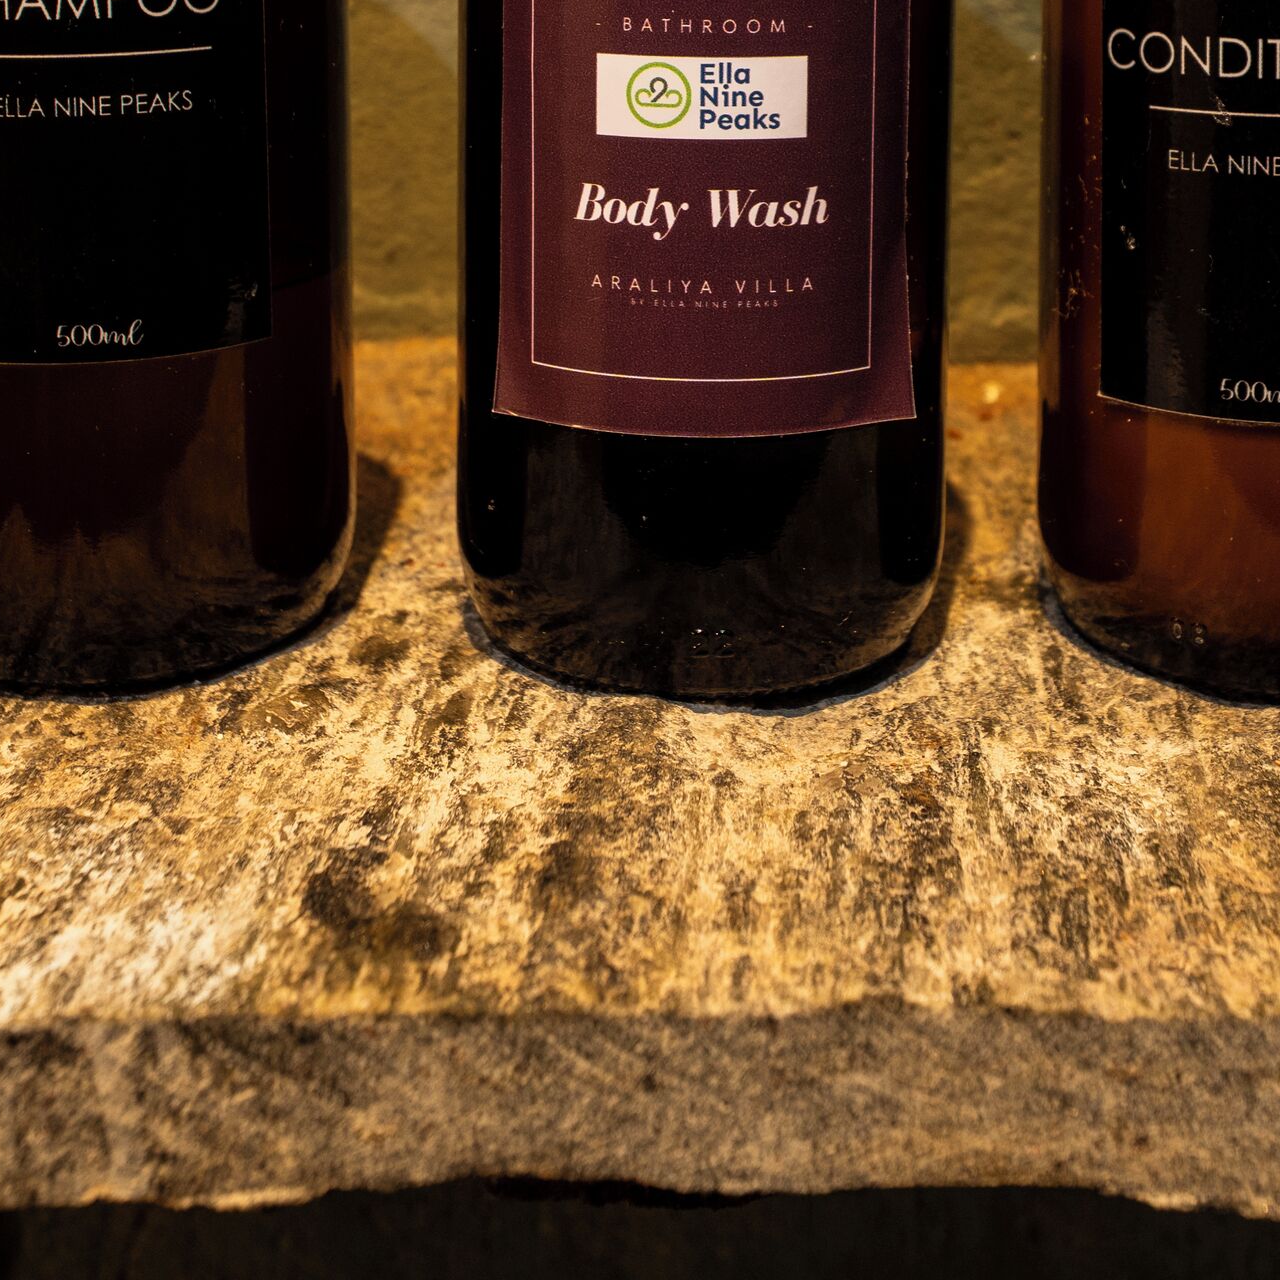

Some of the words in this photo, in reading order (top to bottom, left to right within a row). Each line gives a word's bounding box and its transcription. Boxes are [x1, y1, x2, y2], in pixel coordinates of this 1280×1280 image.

[623, 17, 786, 34] BATHROOM
[699, 62, 751, 85] Ella
[54, 95, 113, 117] NINE
[120, 90, 194, 115] PEAKS
[699, 84, 764, 107] Nine
[699, 108, 781, 130] Peaks
[1167, 149, 1219, 174] ELLA
[573, 182, 690, 241] Body
[707, 185, 830, 227] Wash
[591, 274, 713, 295] ARALIYA
[735, 276, 814, 294] VILLA
[653, 299, 685, 308] ELLA
[694, 300, 728, 309] NINE
[737, 299, 779, 308] PEAKS
[55, 318, 145, 349] 500ml
